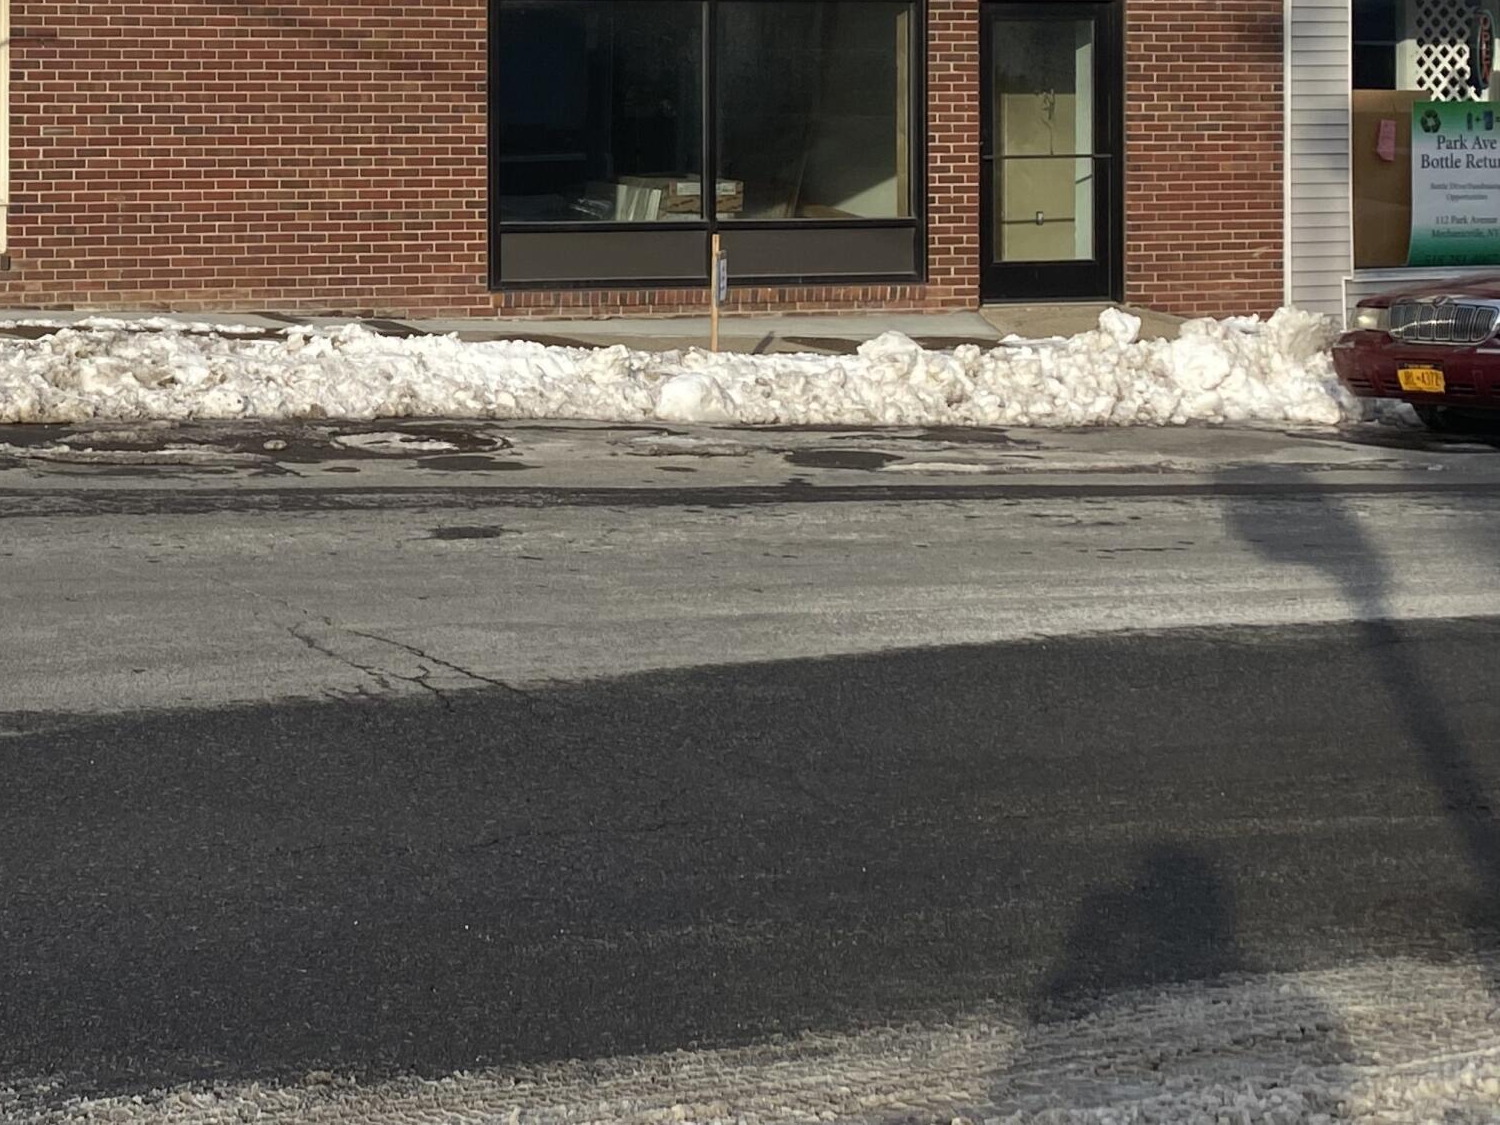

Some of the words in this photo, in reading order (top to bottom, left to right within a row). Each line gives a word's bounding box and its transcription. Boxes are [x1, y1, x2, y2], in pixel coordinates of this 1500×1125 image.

[1437, 134, 1468, 150] Park
[1472, 135, 1497, 150] Ave
[1421, 152, 1462, 169] Bottle
